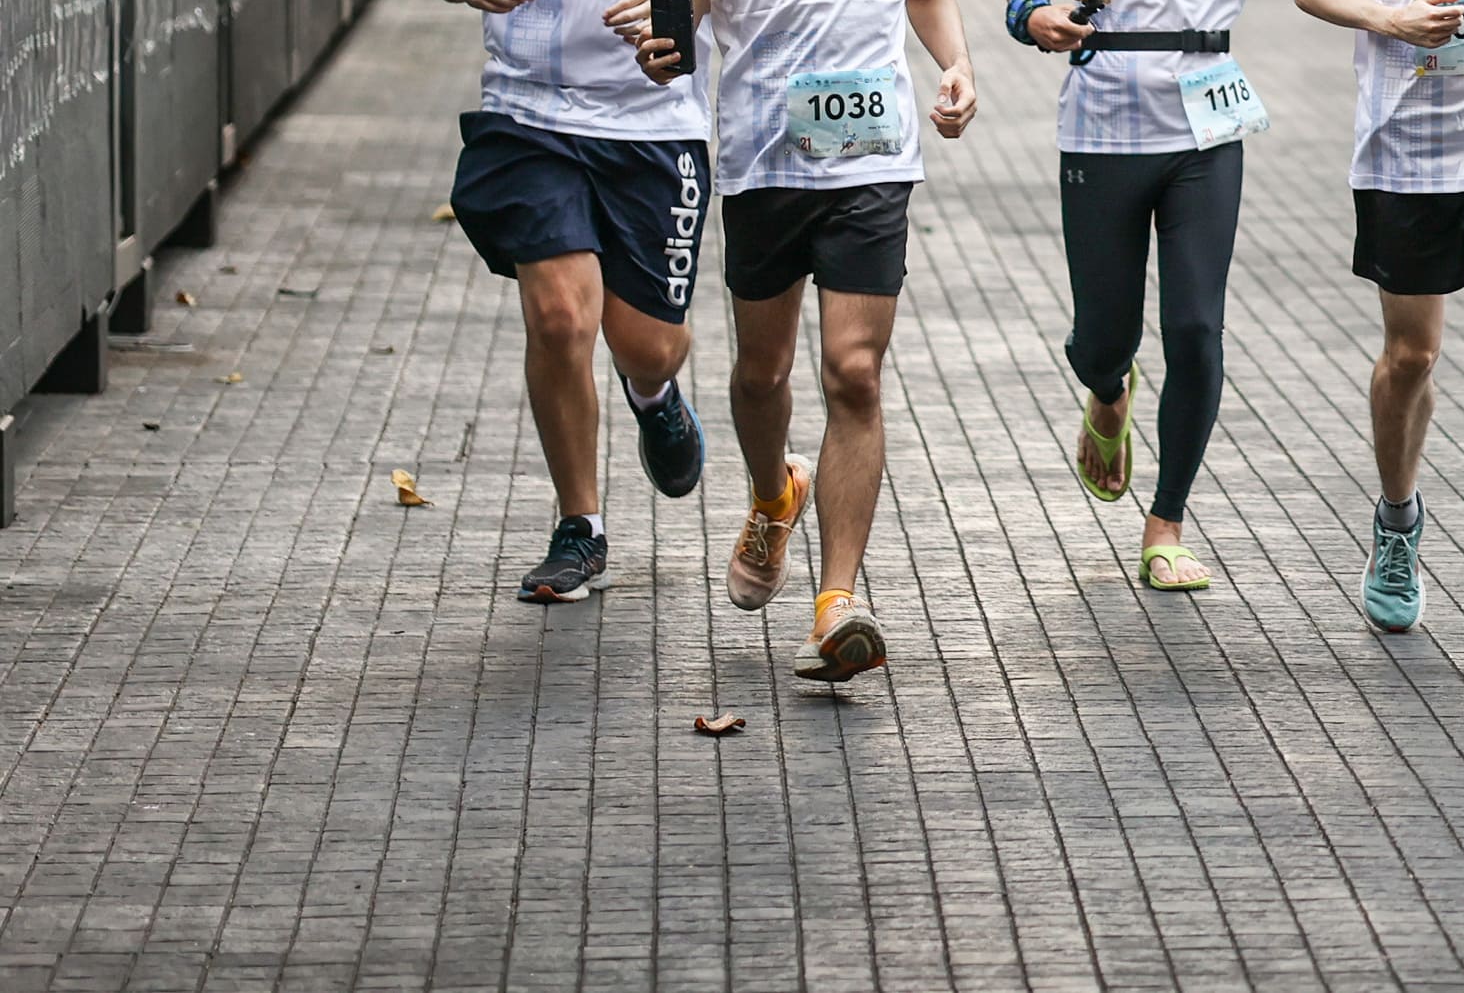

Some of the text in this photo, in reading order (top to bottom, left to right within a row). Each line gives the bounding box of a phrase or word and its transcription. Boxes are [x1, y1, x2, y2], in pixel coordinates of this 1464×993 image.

[807, 91, 885, 121] 1038
[1204, 78, 1250, 112] 1118
[663, 151, 701, 306] adidas
